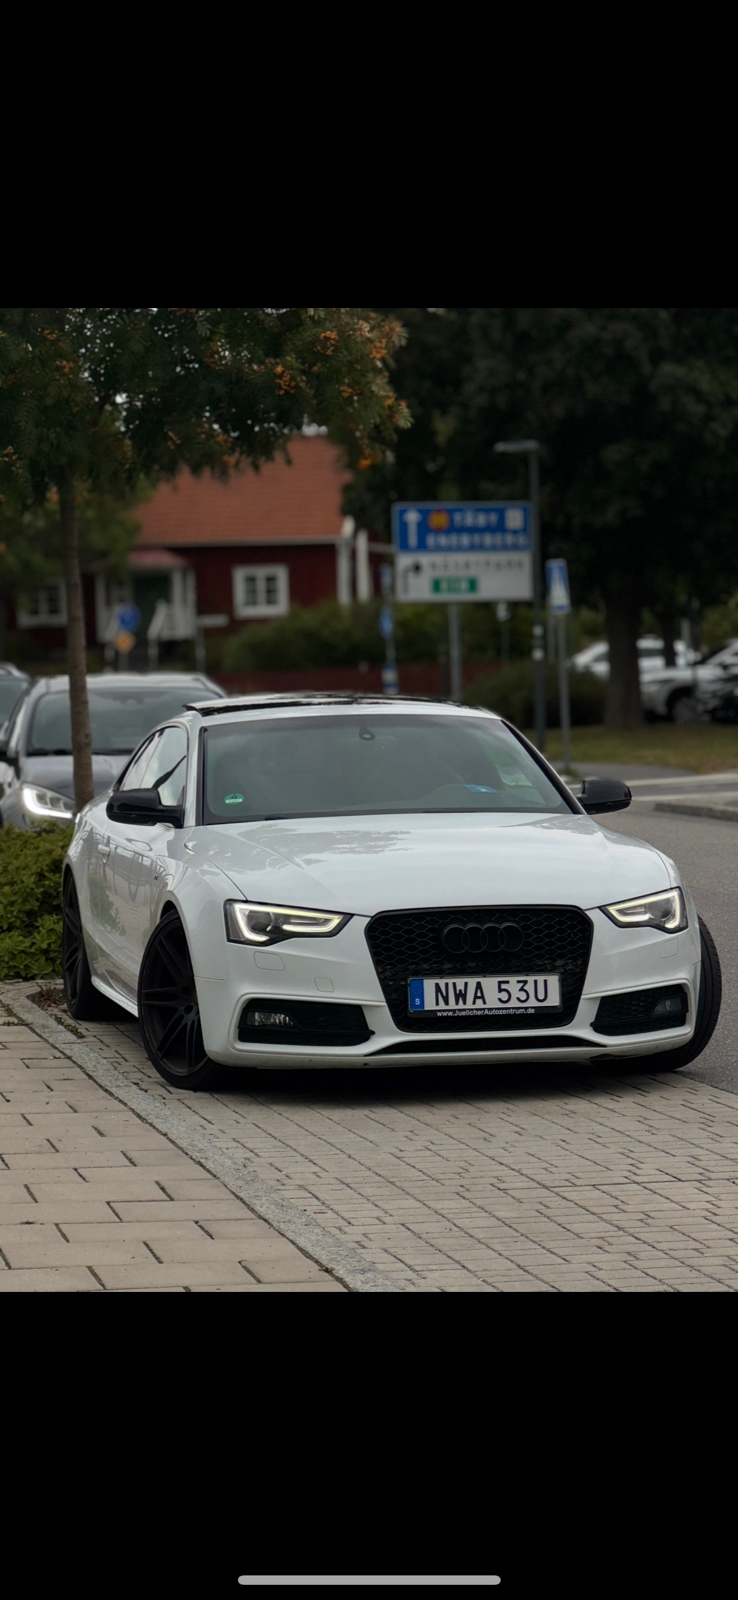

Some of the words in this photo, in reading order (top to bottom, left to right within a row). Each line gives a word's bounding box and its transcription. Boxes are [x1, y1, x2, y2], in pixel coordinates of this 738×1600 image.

[434, 981, 487, 1006] NWA
[497, 979, 548, 1004] 53U
[414, 998, 421, 1006] S
[436, 1007, 536, 1017] www.JuelicherAutozentrum.de
